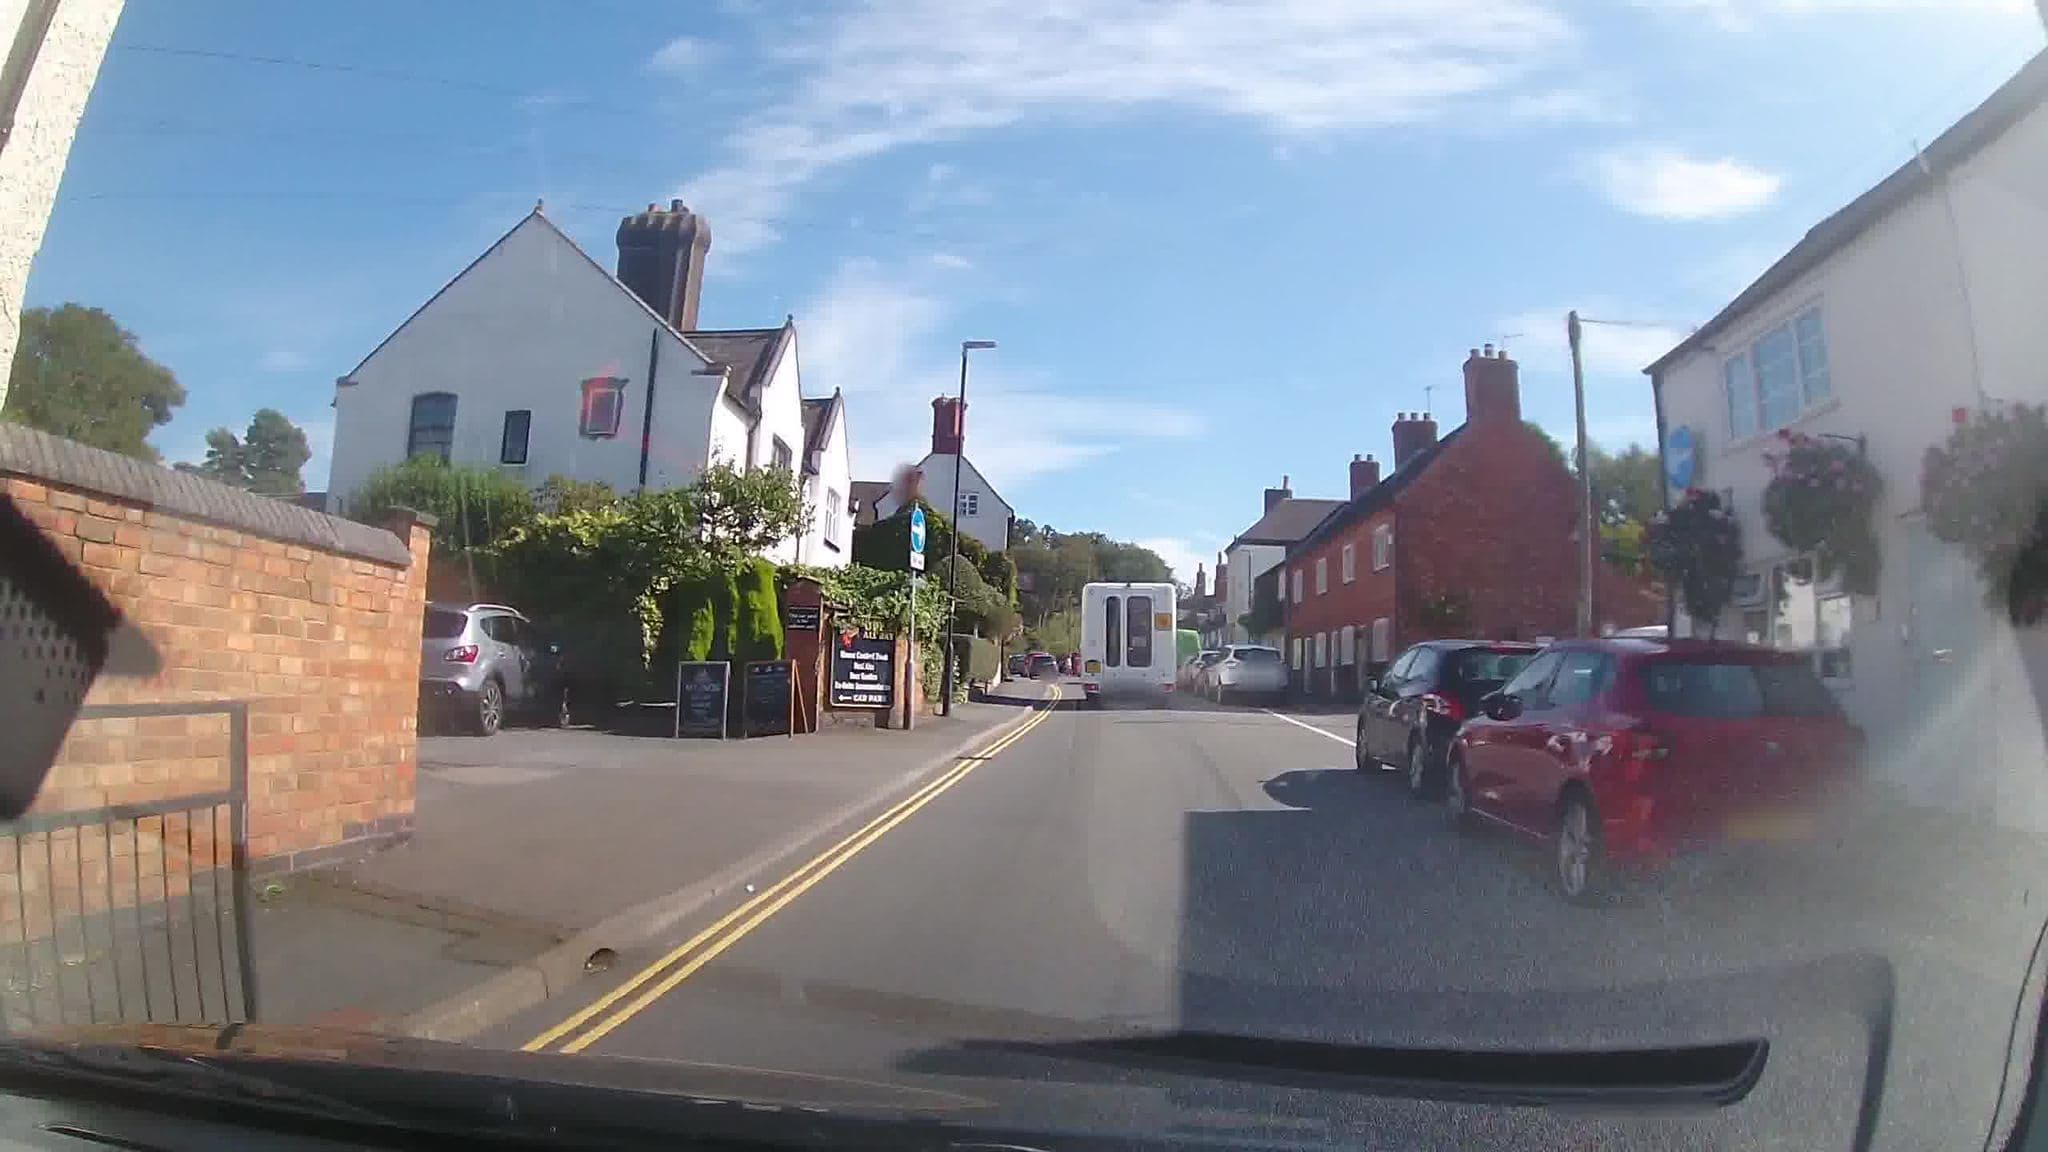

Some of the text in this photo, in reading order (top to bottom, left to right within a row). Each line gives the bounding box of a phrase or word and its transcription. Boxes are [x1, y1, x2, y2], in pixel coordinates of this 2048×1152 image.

[863, 631, 877, 640] ALL
[853, 694, 887, 702] CAR PARK
